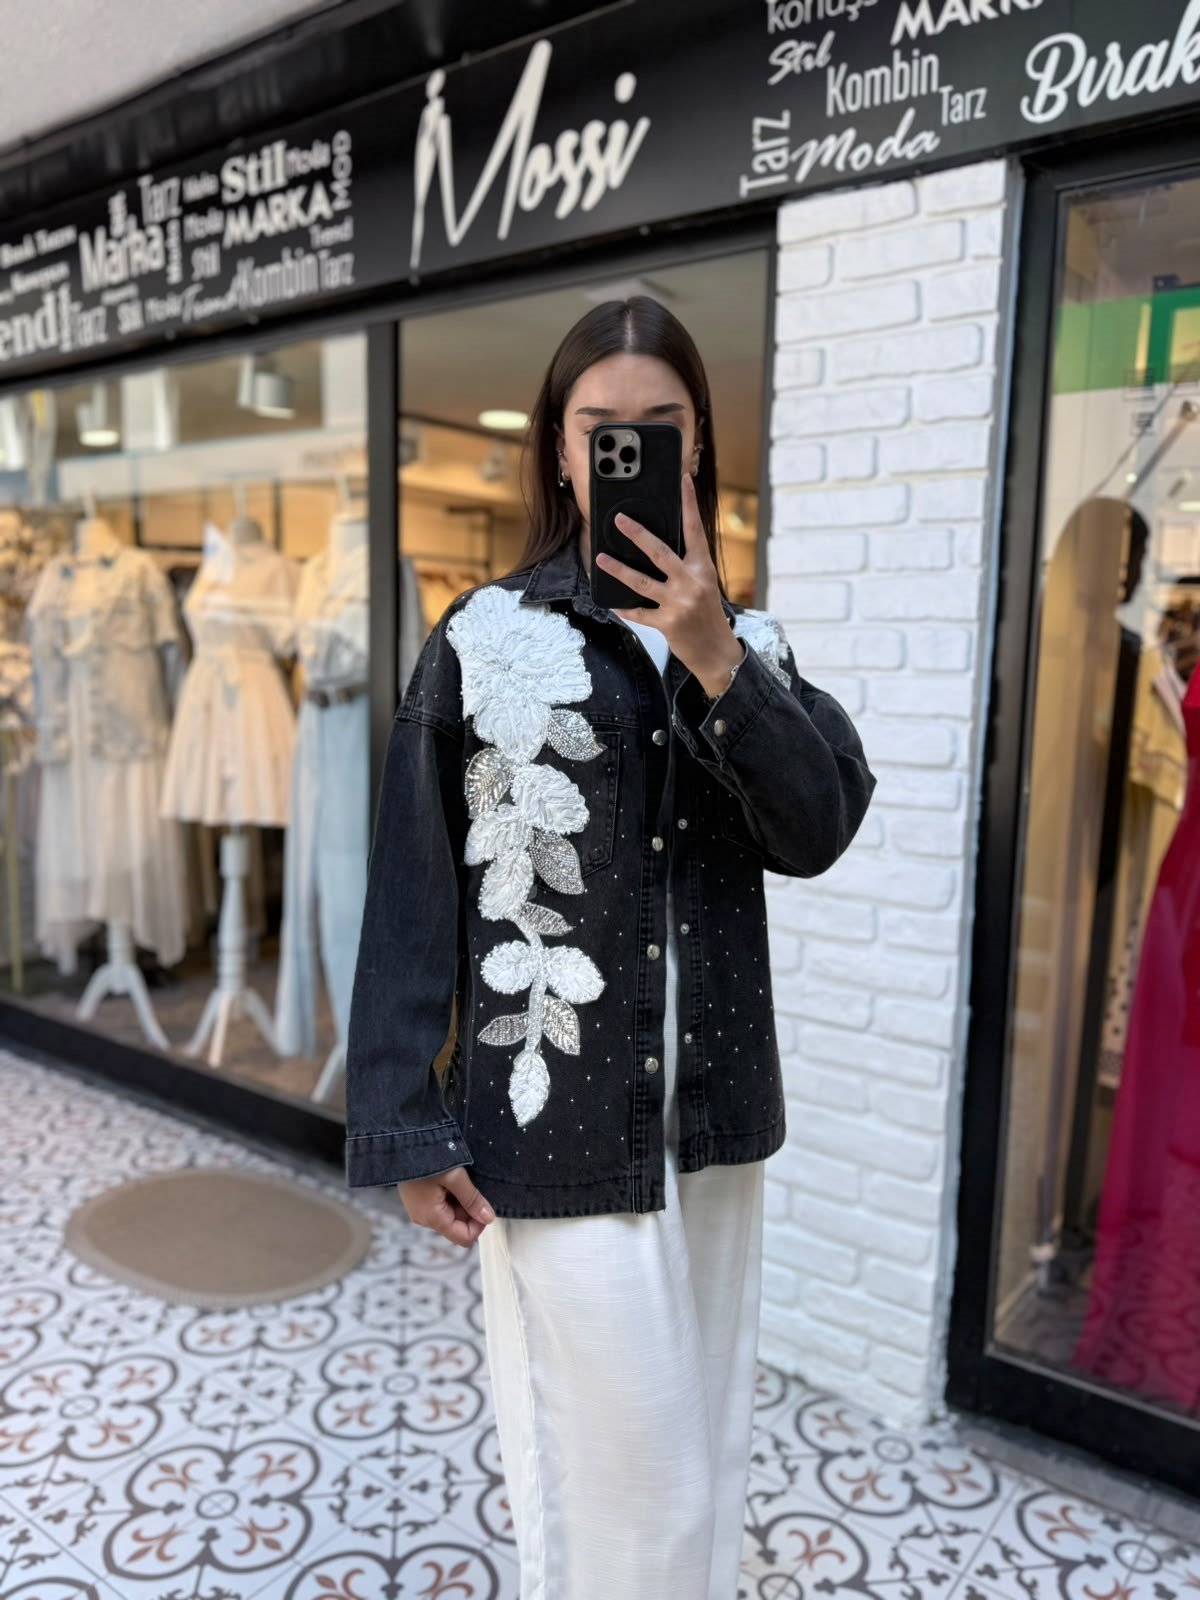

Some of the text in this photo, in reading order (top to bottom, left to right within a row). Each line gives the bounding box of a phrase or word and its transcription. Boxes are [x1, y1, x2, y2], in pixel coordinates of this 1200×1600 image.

[767, 30, 835, 85] Stil
[826, 48, 939, 118] Kombin
[939, 85, 987, 126] Tarz
[221, 139, 288, 205] Stil
[410, 39, 651, 270] Mossi
[739, 109, 791, 198] Tarz
[790, 106, 940, 183] Moda
[222, 180, 334, 249] MARKA
